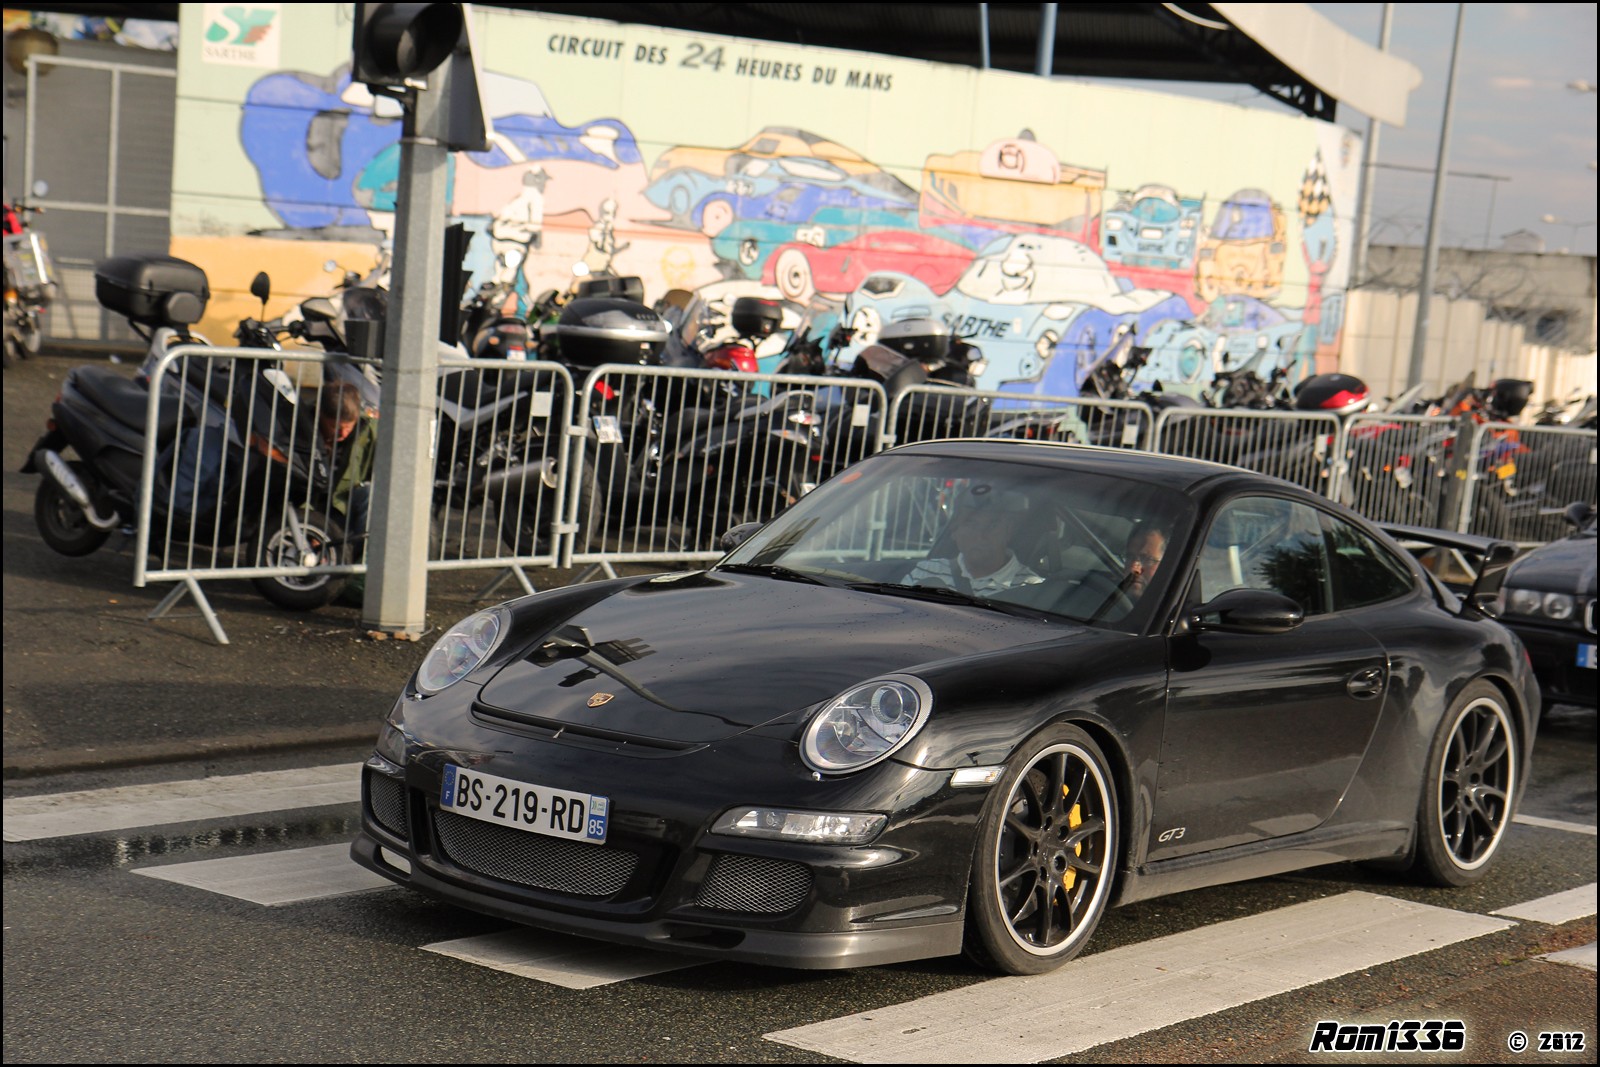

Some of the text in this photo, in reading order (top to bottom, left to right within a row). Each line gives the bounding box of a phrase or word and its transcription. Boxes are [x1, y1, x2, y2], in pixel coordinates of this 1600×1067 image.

[548, 34, 893, 92] CIRCUIT DES 24 HEURES DU MANS
[941, 312, 1011, 338] SARTHE
[445, 790, 451, 800] F
[456, 773, 585, 834] BS-219-RD
[588, 819, 604, 836] 85
[1158, 827, 1186, 842] GT3
